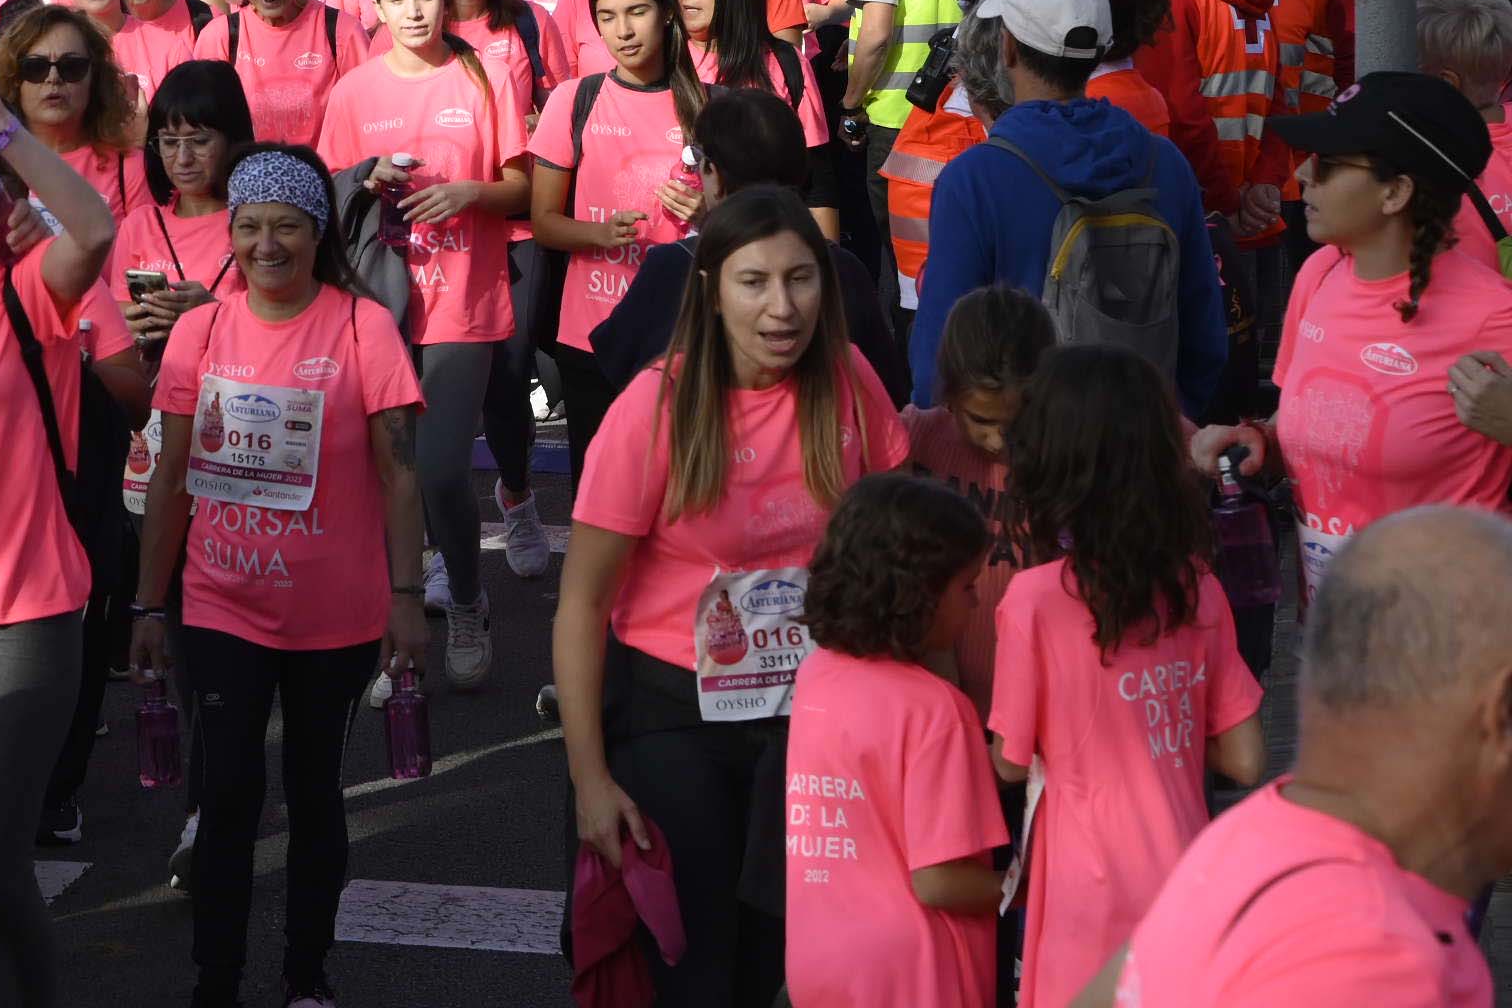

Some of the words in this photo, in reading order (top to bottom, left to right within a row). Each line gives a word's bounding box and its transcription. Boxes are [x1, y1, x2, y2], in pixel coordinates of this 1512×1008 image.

[363, 118, 403, 134] OYSHO
[411, 229, 471, 254] RSAL
[588, 270, 629, 297] SUM
[229, 403, 276, 418] ASTURIANA
[228, 430, 272, 450] 016
[231, 453, 265, 466] 15175
[201, 461, 231, 475] CARRERA
[232, 468, 243, 477] DE
[245, 470, 255, 478] LA
[256, 471, 283, 481] MUJER
[194, 478, 232, 493] OYSHO
[263, 488, 303, 502] Santander
[129, 496, 146, 507] OYS
[208, 498, 324, 536] DORSAL
[204, 536, 289, 577] SUMA
[747, 595, 803, 609] ASTURIANA
[753, 626, 803, 650] 016
[718, 676, 763, 688] CARRERA
[765, 675, 778, 684] DE
[780, 674, 793, 683] LA
[716, 697, 767, 712] OYSHO
[788, 773, 865, 801] ARRERA
[820, 806, 849, 829] LA
[786, 834, 858, 860] MUJER
